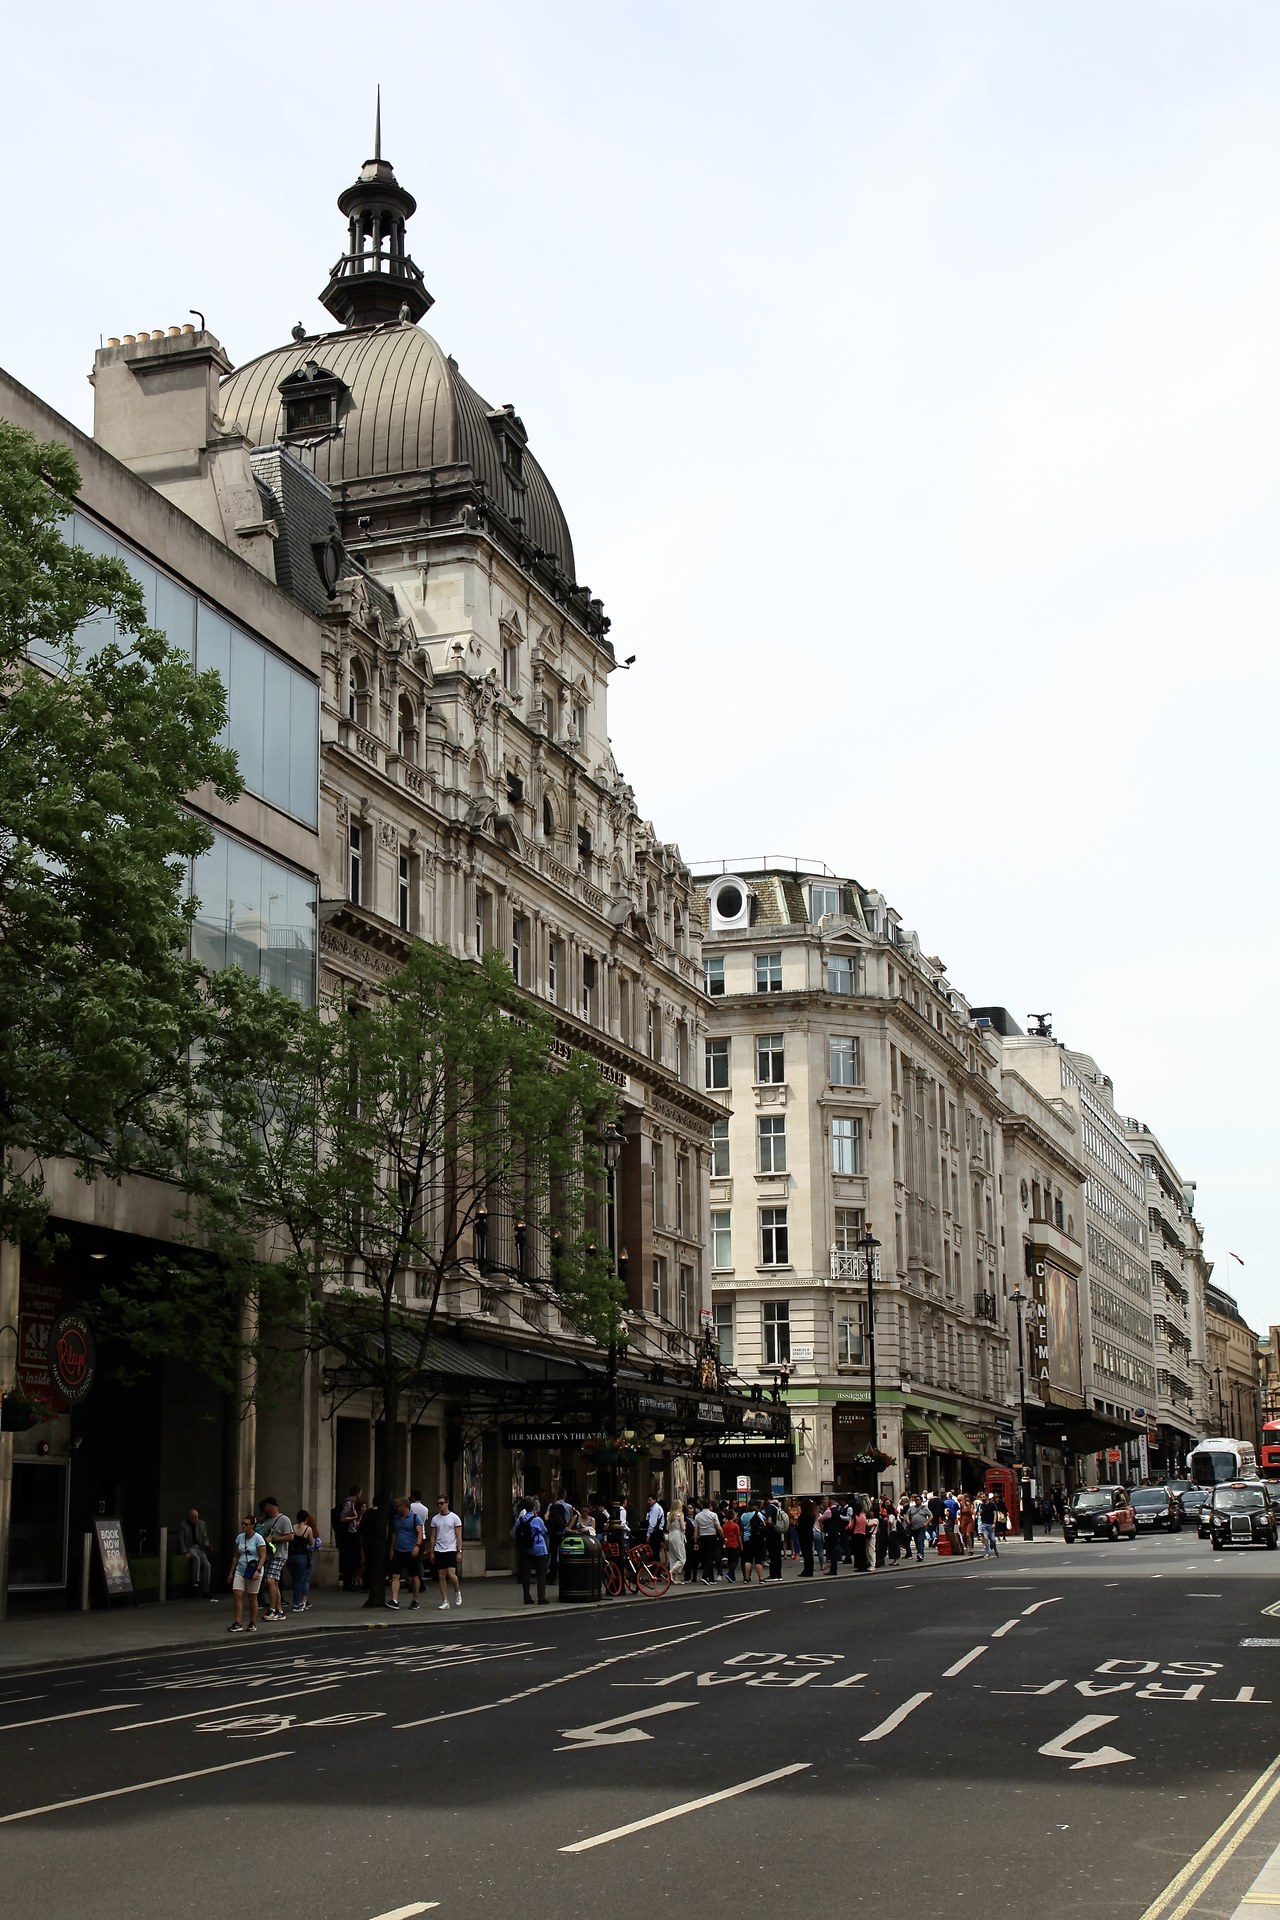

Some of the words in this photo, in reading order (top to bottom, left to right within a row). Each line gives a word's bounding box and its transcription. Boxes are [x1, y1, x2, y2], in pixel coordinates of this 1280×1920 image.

[597, 1061, 627, 1087] HEATRE
[59, 1316, 77, 1332] SPORTS
[1036, 1262, 1050, 1380] CINEMA
[25, 1371, 51, 1386] inside
[508, 1433, 525, 1441] HER
[526, 1433, 568, 1442] MAJESTY'S
[100, 1529, 120, 1540] BOOK
[103, 1540, 120, 1550] NOW
[107, 1549, 121, 1559] FOR
[722, 1651, 845, 1667] SQ
[1093, 1658, 1225, 1677] SQ
[610, 1671, 869, 1688] TRAF
[989, 1679, 1273, 1704] TRAF
